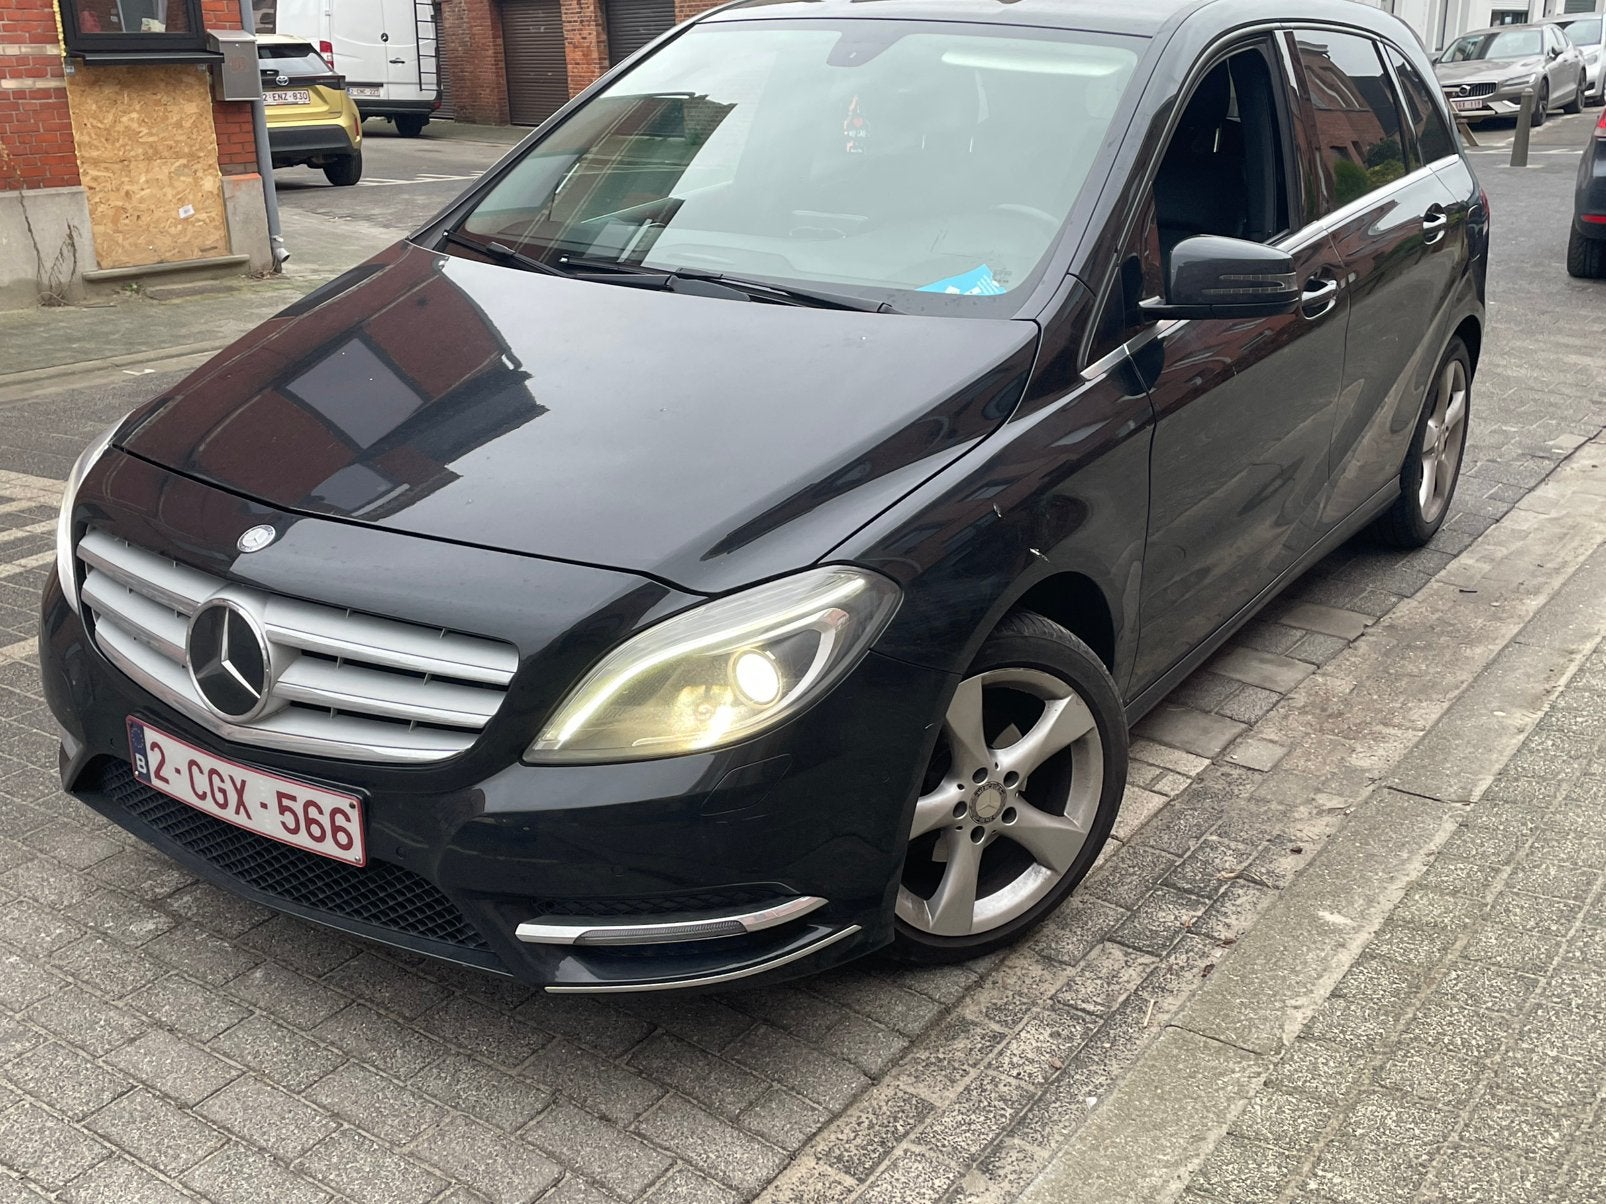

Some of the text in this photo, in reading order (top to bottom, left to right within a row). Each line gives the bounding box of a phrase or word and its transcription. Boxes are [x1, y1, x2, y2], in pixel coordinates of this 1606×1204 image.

[262, 91, 308, 101] 2-ENZ-830
[135, 752, 147, 774] B
[149, 741, 354, 851] 2-CGX-566
